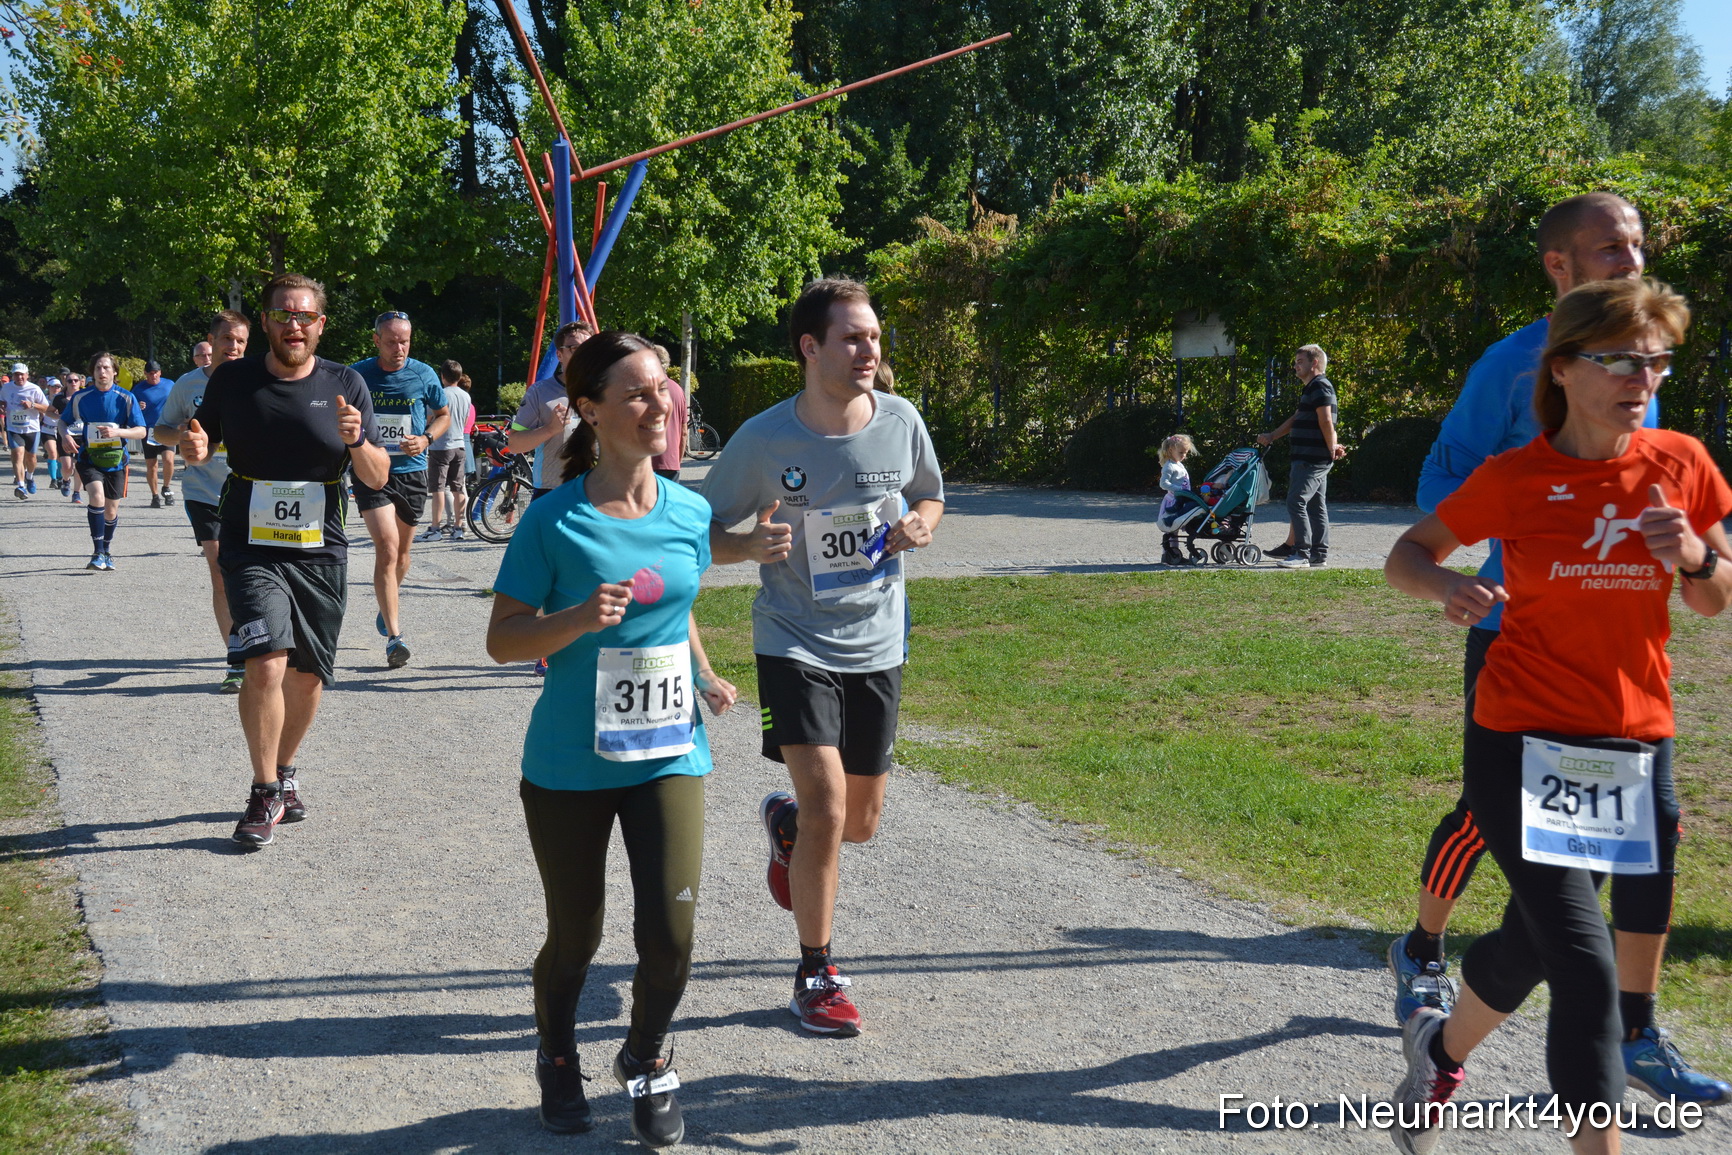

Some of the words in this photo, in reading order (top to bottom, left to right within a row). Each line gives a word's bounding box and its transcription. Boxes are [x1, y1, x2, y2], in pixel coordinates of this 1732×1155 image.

[855, 470, 902, 484] BOCK
[272, 487, 305, 496] BOCK
[783, 494, 810, 503] PARTL
[1547, 492, 1575, 501] erima
[275, 500, 302, 521] 64
[833, 511, 875, 525] BOCK
[273, 530, 302, 541] Harald
[821, 524, 884, 559] 301
[829, 561, 849, 569] PARTL
[1548, 561, 1656, 580] funrunners
[1580, 576, 1662, 591] neumarkt
[633, 655, 675, 669] BOCK
[614, 675, 684, 713] 3115
[620, 717, 645, 725] PARTL
[646, 715, 674, 725] Neumarkt
[1558, 756, 1615, 775] BOCK
[1540, 774, 1624, 821] 2511
[1546, 817, 1572, 829] PARTL
[1573, 822, 1612, 834] Neumarkt
[1567, 837, 1602, 856] Gabi
